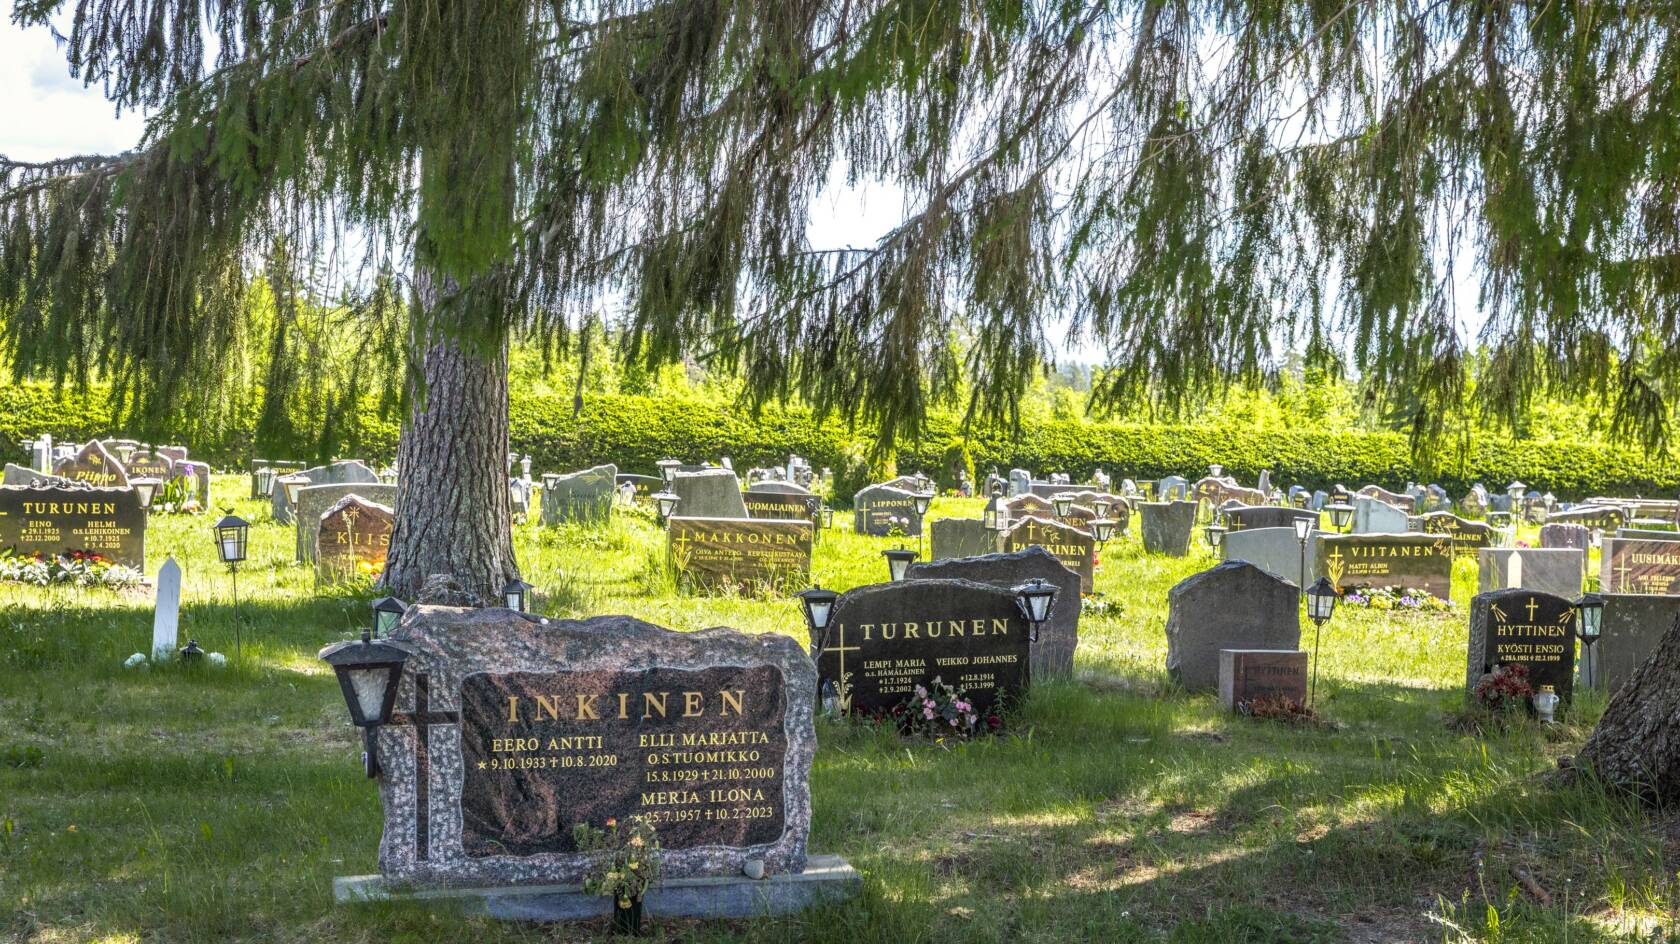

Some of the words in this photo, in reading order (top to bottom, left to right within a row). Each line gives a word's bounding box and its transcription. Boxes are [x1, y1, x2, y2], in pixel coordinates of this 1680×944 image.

[132, 466, 167, 474] IKONEN
[76, 471, 117, 484] Piippo
[23, 502, 116, 515] TURUNEN
[872, 500, 913, 508] LIPPONEN
[29, 520, 52, 528] EINO
[87, 520, 116, 528] HELMI
[694, 531, 798, 545] MAKKONEN
[1352, 546, 1434, 557] VIITANEN
[860, 618, 1009, 640] TURUNEN
[1497, 624, 1566, 637] HYTTINEN
[1497, 643, 1532, 654] KYÖSTI
[1535, 644, 1564, 654] ENSIO
[864, 660, 892, 669] LEMPI
[895, 658, 927, 669] MARIA
[936, 657, 969, 666] VEIKKO
[972, 654, 1018, 665] JOHANNES
[878, 667, 925, 677] HÄMÄLÄINEN
[507, 690, 746, 722] INKINEN
[492, 738, 539, 752] EERO
[547, 735, 603, 750] ANTTI
[639, 733, 675, 747] ELLI
[682, 731, 770, 746] MARJATTA
[491, 757, 546, 770] 9.10.1933
[561, 754, 618, 768] 10.8.2020
[647, 769, 699, 782] 15.8.1929
[712, 767, 775, 780] 21.10.2000
[641, 791, 700, 806] MERJA
[710, 788, 765, 803] ILONA
[716, 806, 773, 821] 10.2.2023
